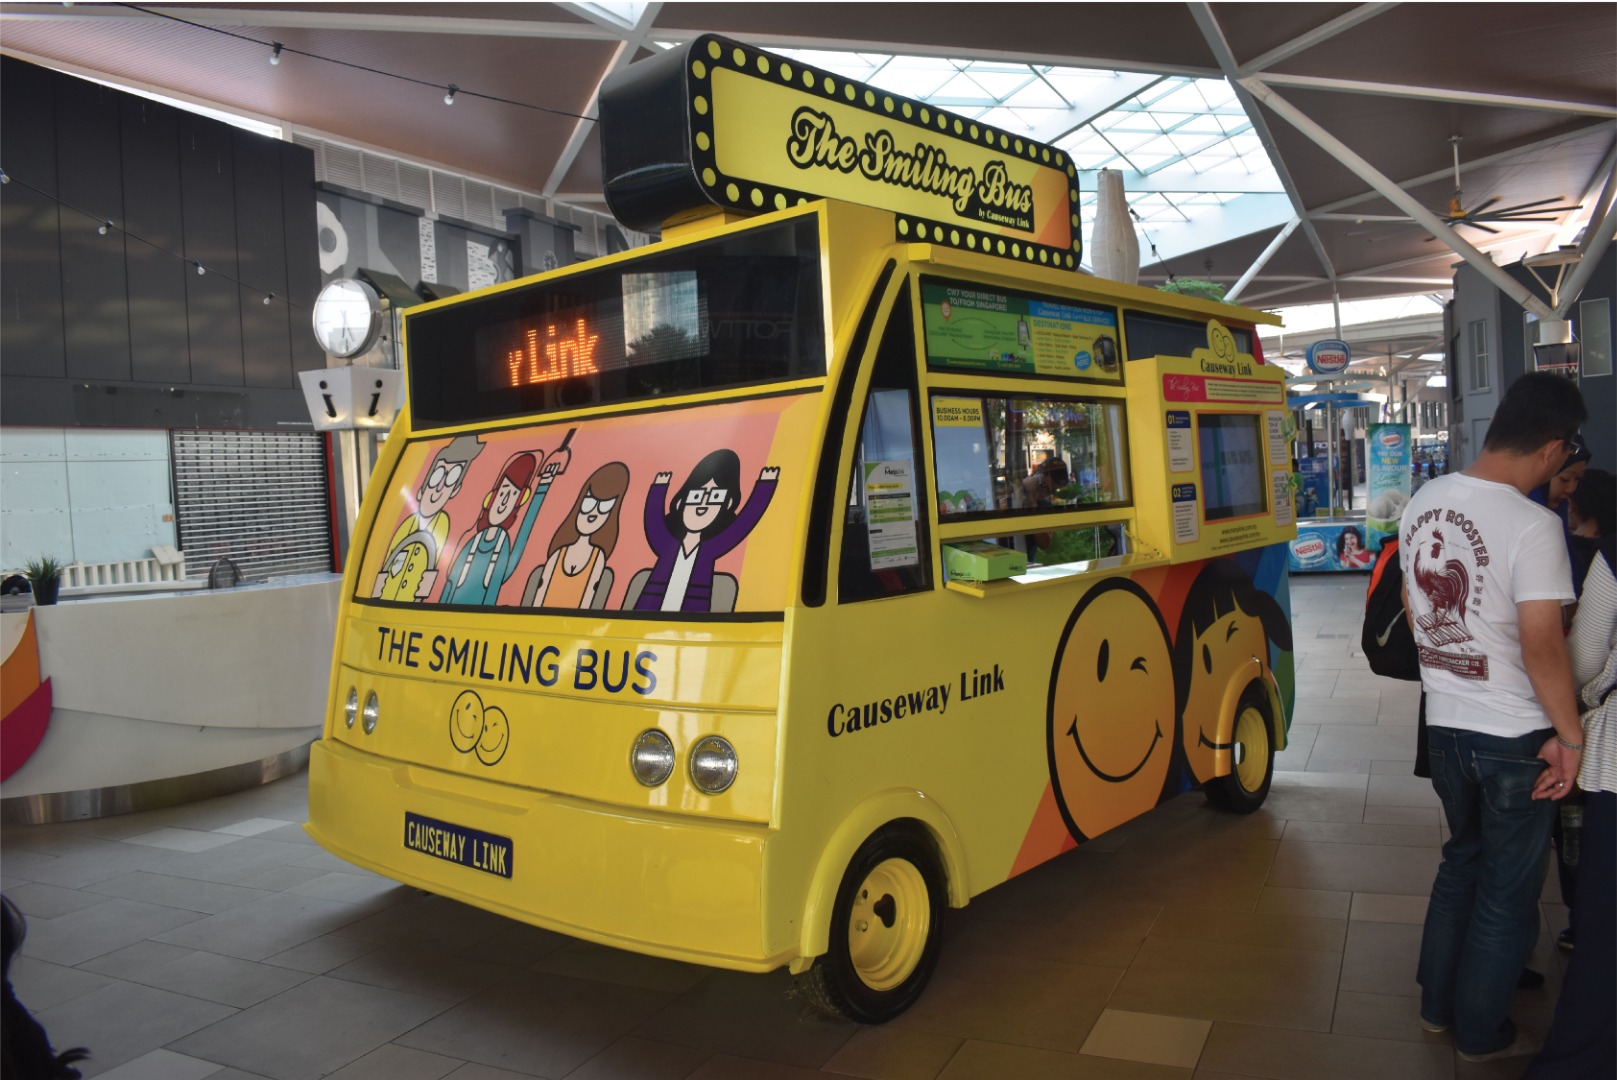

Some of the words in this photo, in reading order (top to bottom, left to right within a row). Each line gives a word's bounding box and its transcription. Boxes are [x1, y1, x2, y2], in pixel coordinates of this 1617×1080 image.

[789, 108, 855, 171] The
[862, 131, 975, 210] Smiling
[980, 161, 1034, 213] Bus
[978, 207, 985, 219] by
[986, 209, 1016, 227] Causeway
[1016, 217, 1030, 228] Link
[527, 319, 599, 383] Link
[1317, 354, 1345, 364] Nestlé
[1200, 358, 1236, 378] Causeway
[1237, 362, 1253, 376] Link
[936, 407, 961, 415] BUSINESS
[1168, 414, 1175, 425] 01
[1381, 457, 1399, 465] NEW
[1173, 487, 1181, 498] 02
[1405, 508, 1443, 547] HAPPY
[1445, 509, 1490, 568] ROOSTER
[378, 627, 423, 668] THE
[428, 635, 560, 687] SMILING
[573, 648, 658, 695] BUS
[827, 683, 952, 738] Causeway
[960, 663, 1005, 702] Link
[408, 821, 466, 862] CAUSEWAY
[473, 839, 507, 875] LINK
